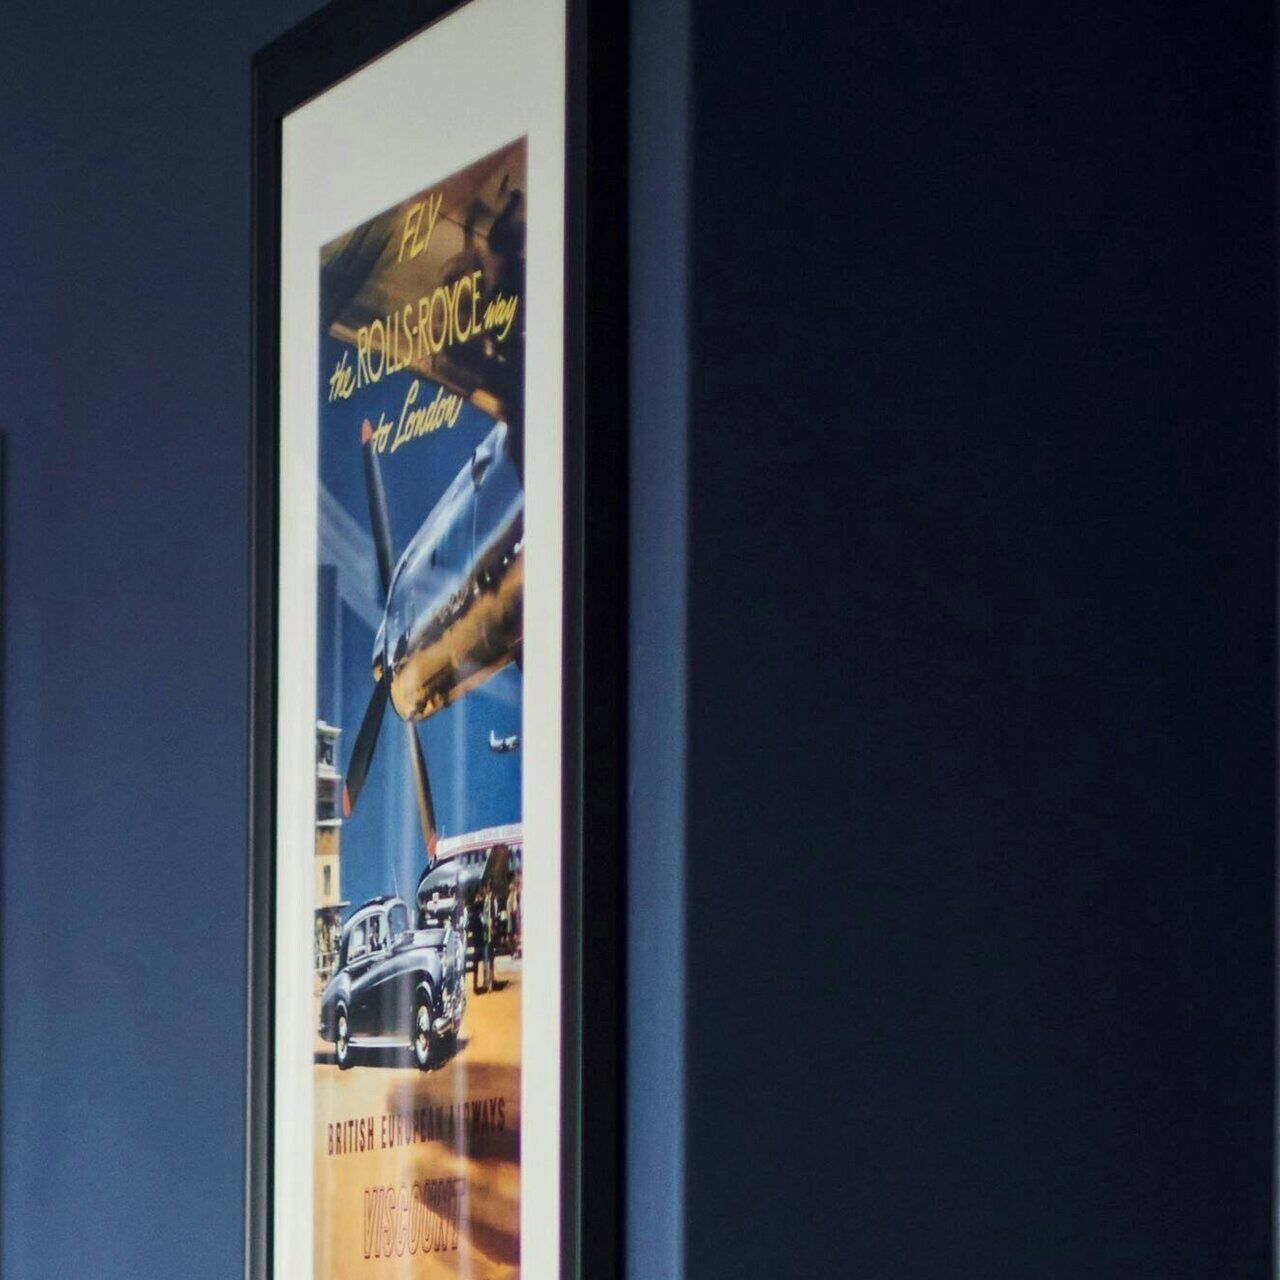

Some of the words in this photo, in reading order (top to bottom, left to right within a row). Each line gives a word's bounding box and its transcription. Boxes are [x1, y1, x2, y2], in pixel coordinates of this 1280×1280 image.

[398, 193, 442, 264] FLY
[329, 351, 356, 403] the
[357, 270, 483, 389] ROLLS-ROYCE
[484, 292, 518, 342] way
[372, 413, 390, 456] to
[391, 379, 463, 454] London
[328, 1116, 374, 1156] BRITISH
